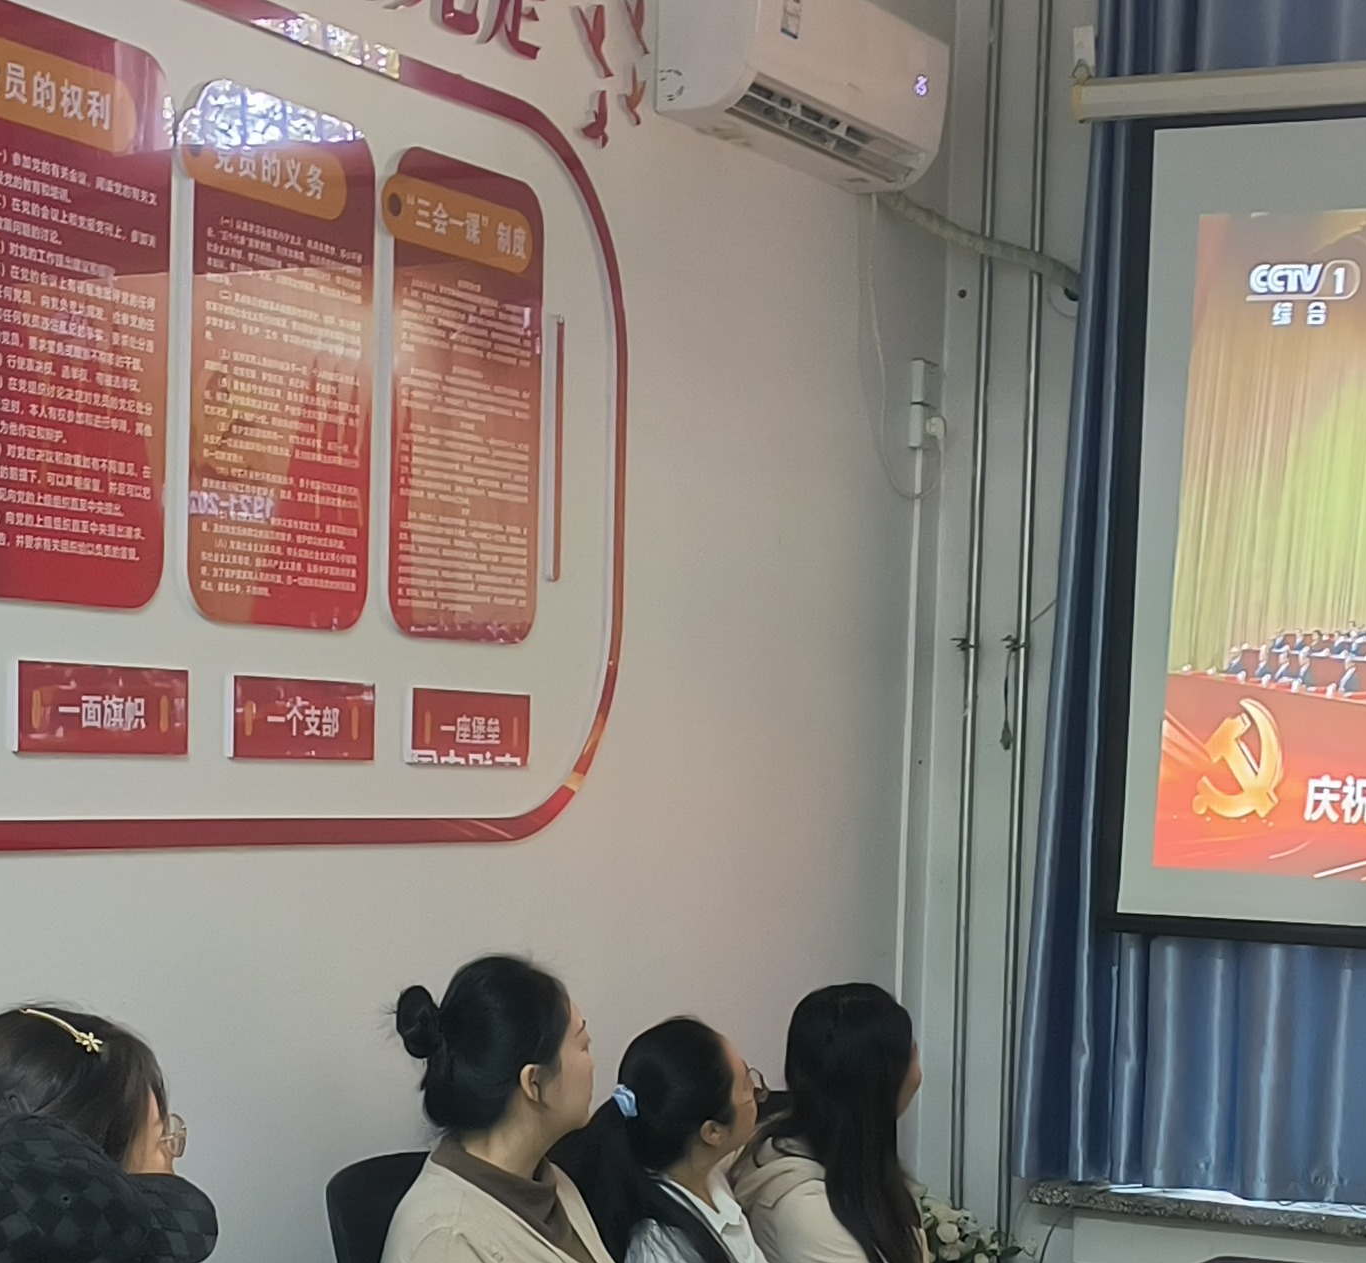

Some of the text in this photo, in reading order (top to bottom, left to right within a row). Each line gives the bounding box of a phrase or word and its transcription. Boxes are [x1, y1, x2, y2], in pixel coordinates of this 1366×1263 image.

[1249, 263, 1323, 293] CCTV
[1270, 302, 1327, 326] 综合
[58, 694, 146, 731] 一面旗帜
[267, 705, 339, 738] 一个支部
[440, 714, 501, 744] 一座堡垒
